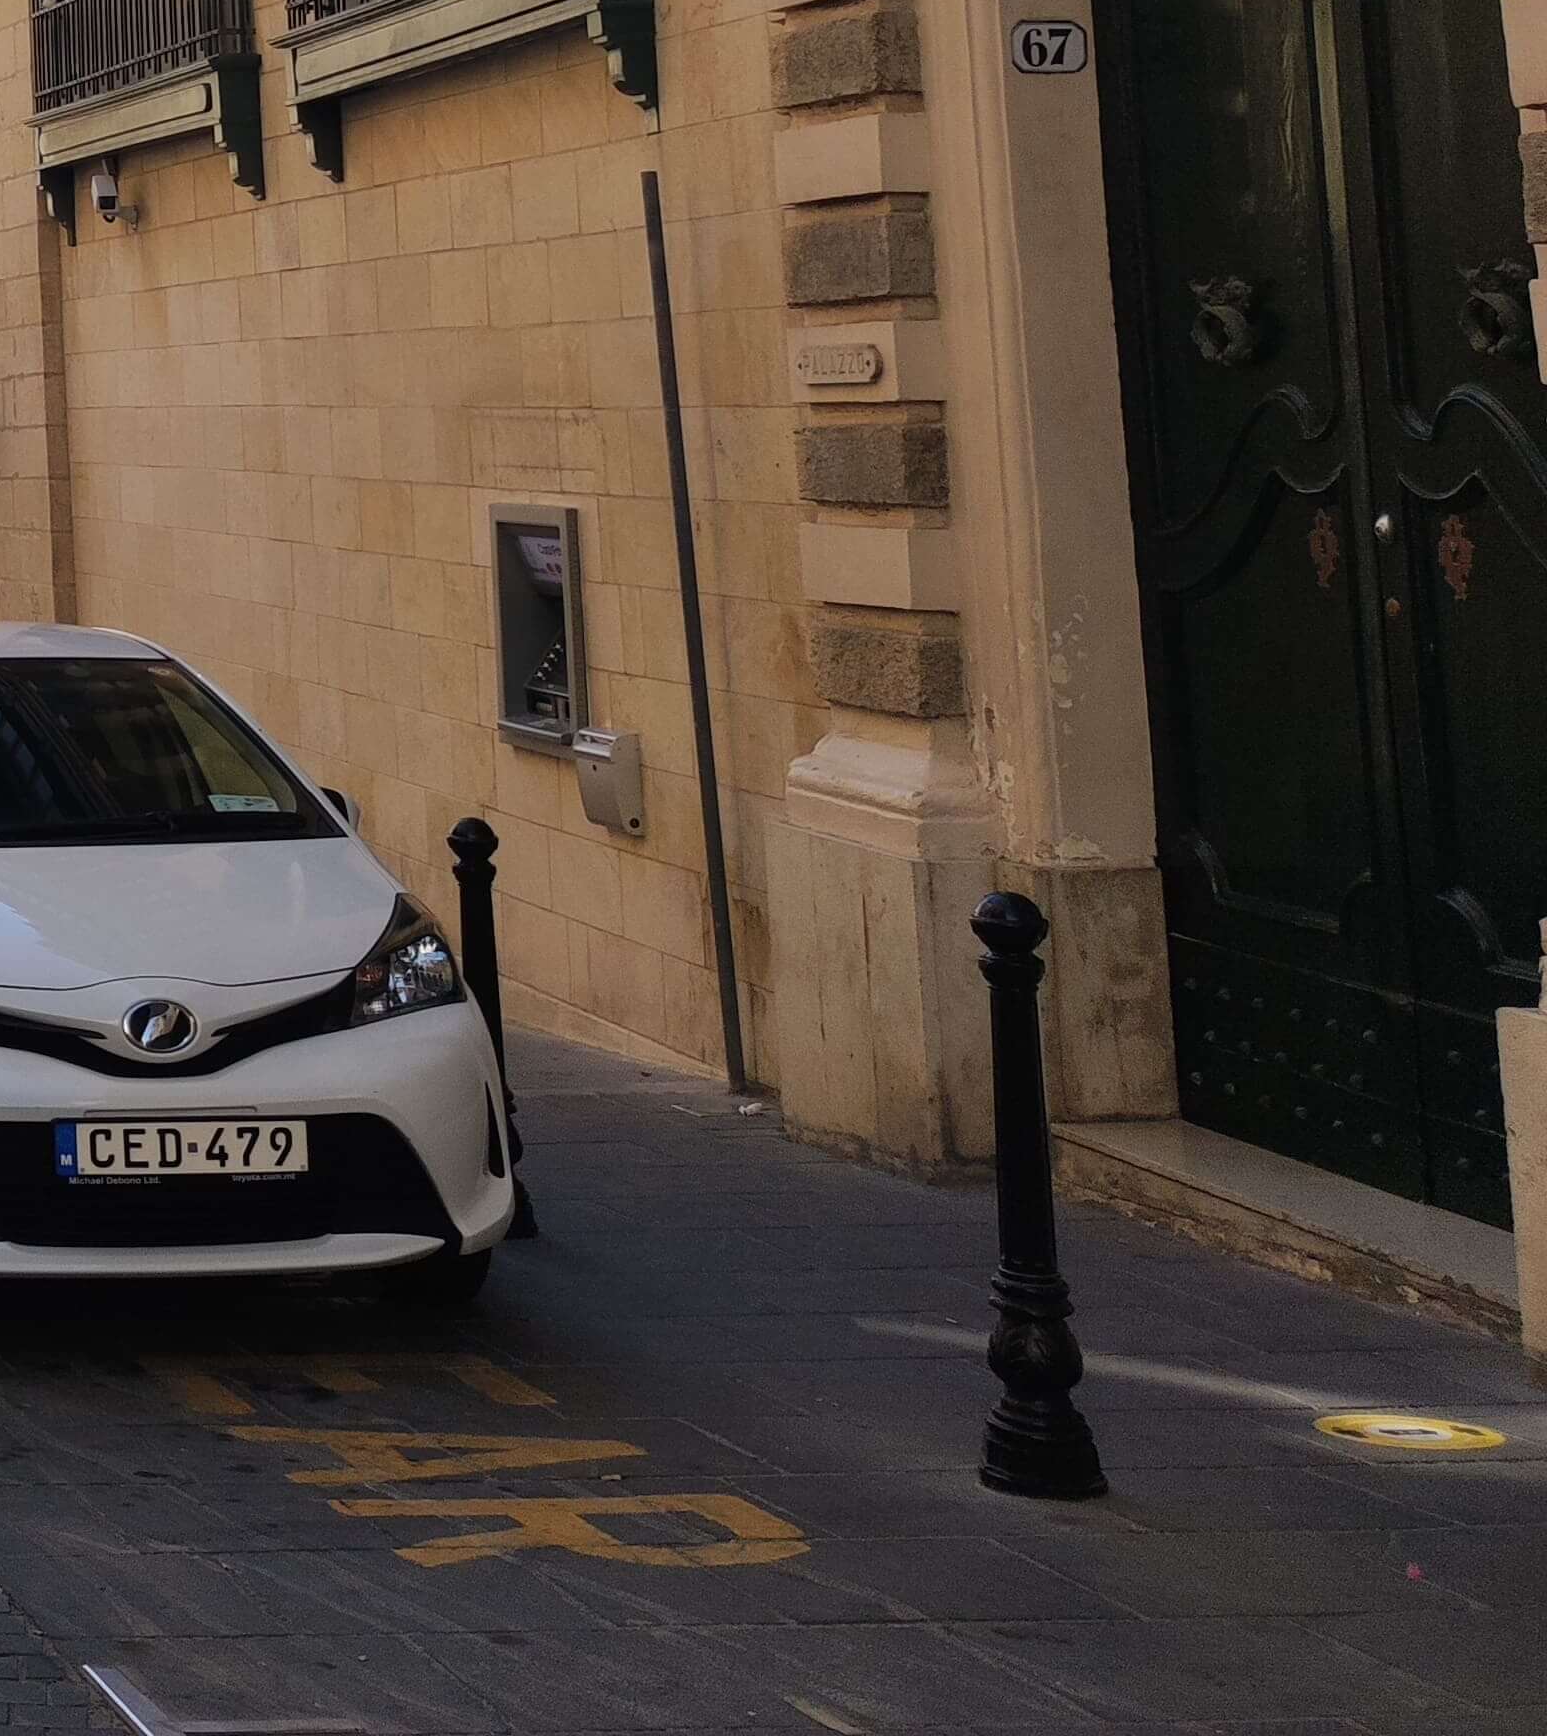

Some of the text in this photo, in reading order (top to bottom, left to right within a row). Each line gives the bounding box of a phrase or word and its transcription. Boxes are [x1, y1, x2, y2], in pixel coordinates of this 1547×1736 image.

[1022, 28, 1072, 67] 67
[802, 352, 866, 376] PALAZZO
[89, 1126, 293, 1169] CED 479
[59, 1154, 73, 1167] M
[69, 1176, 105, 1185] Michael
[106, 1176, 142, 1185] Debono
[231, 1173, 296, 1183] toyota.com.mt
